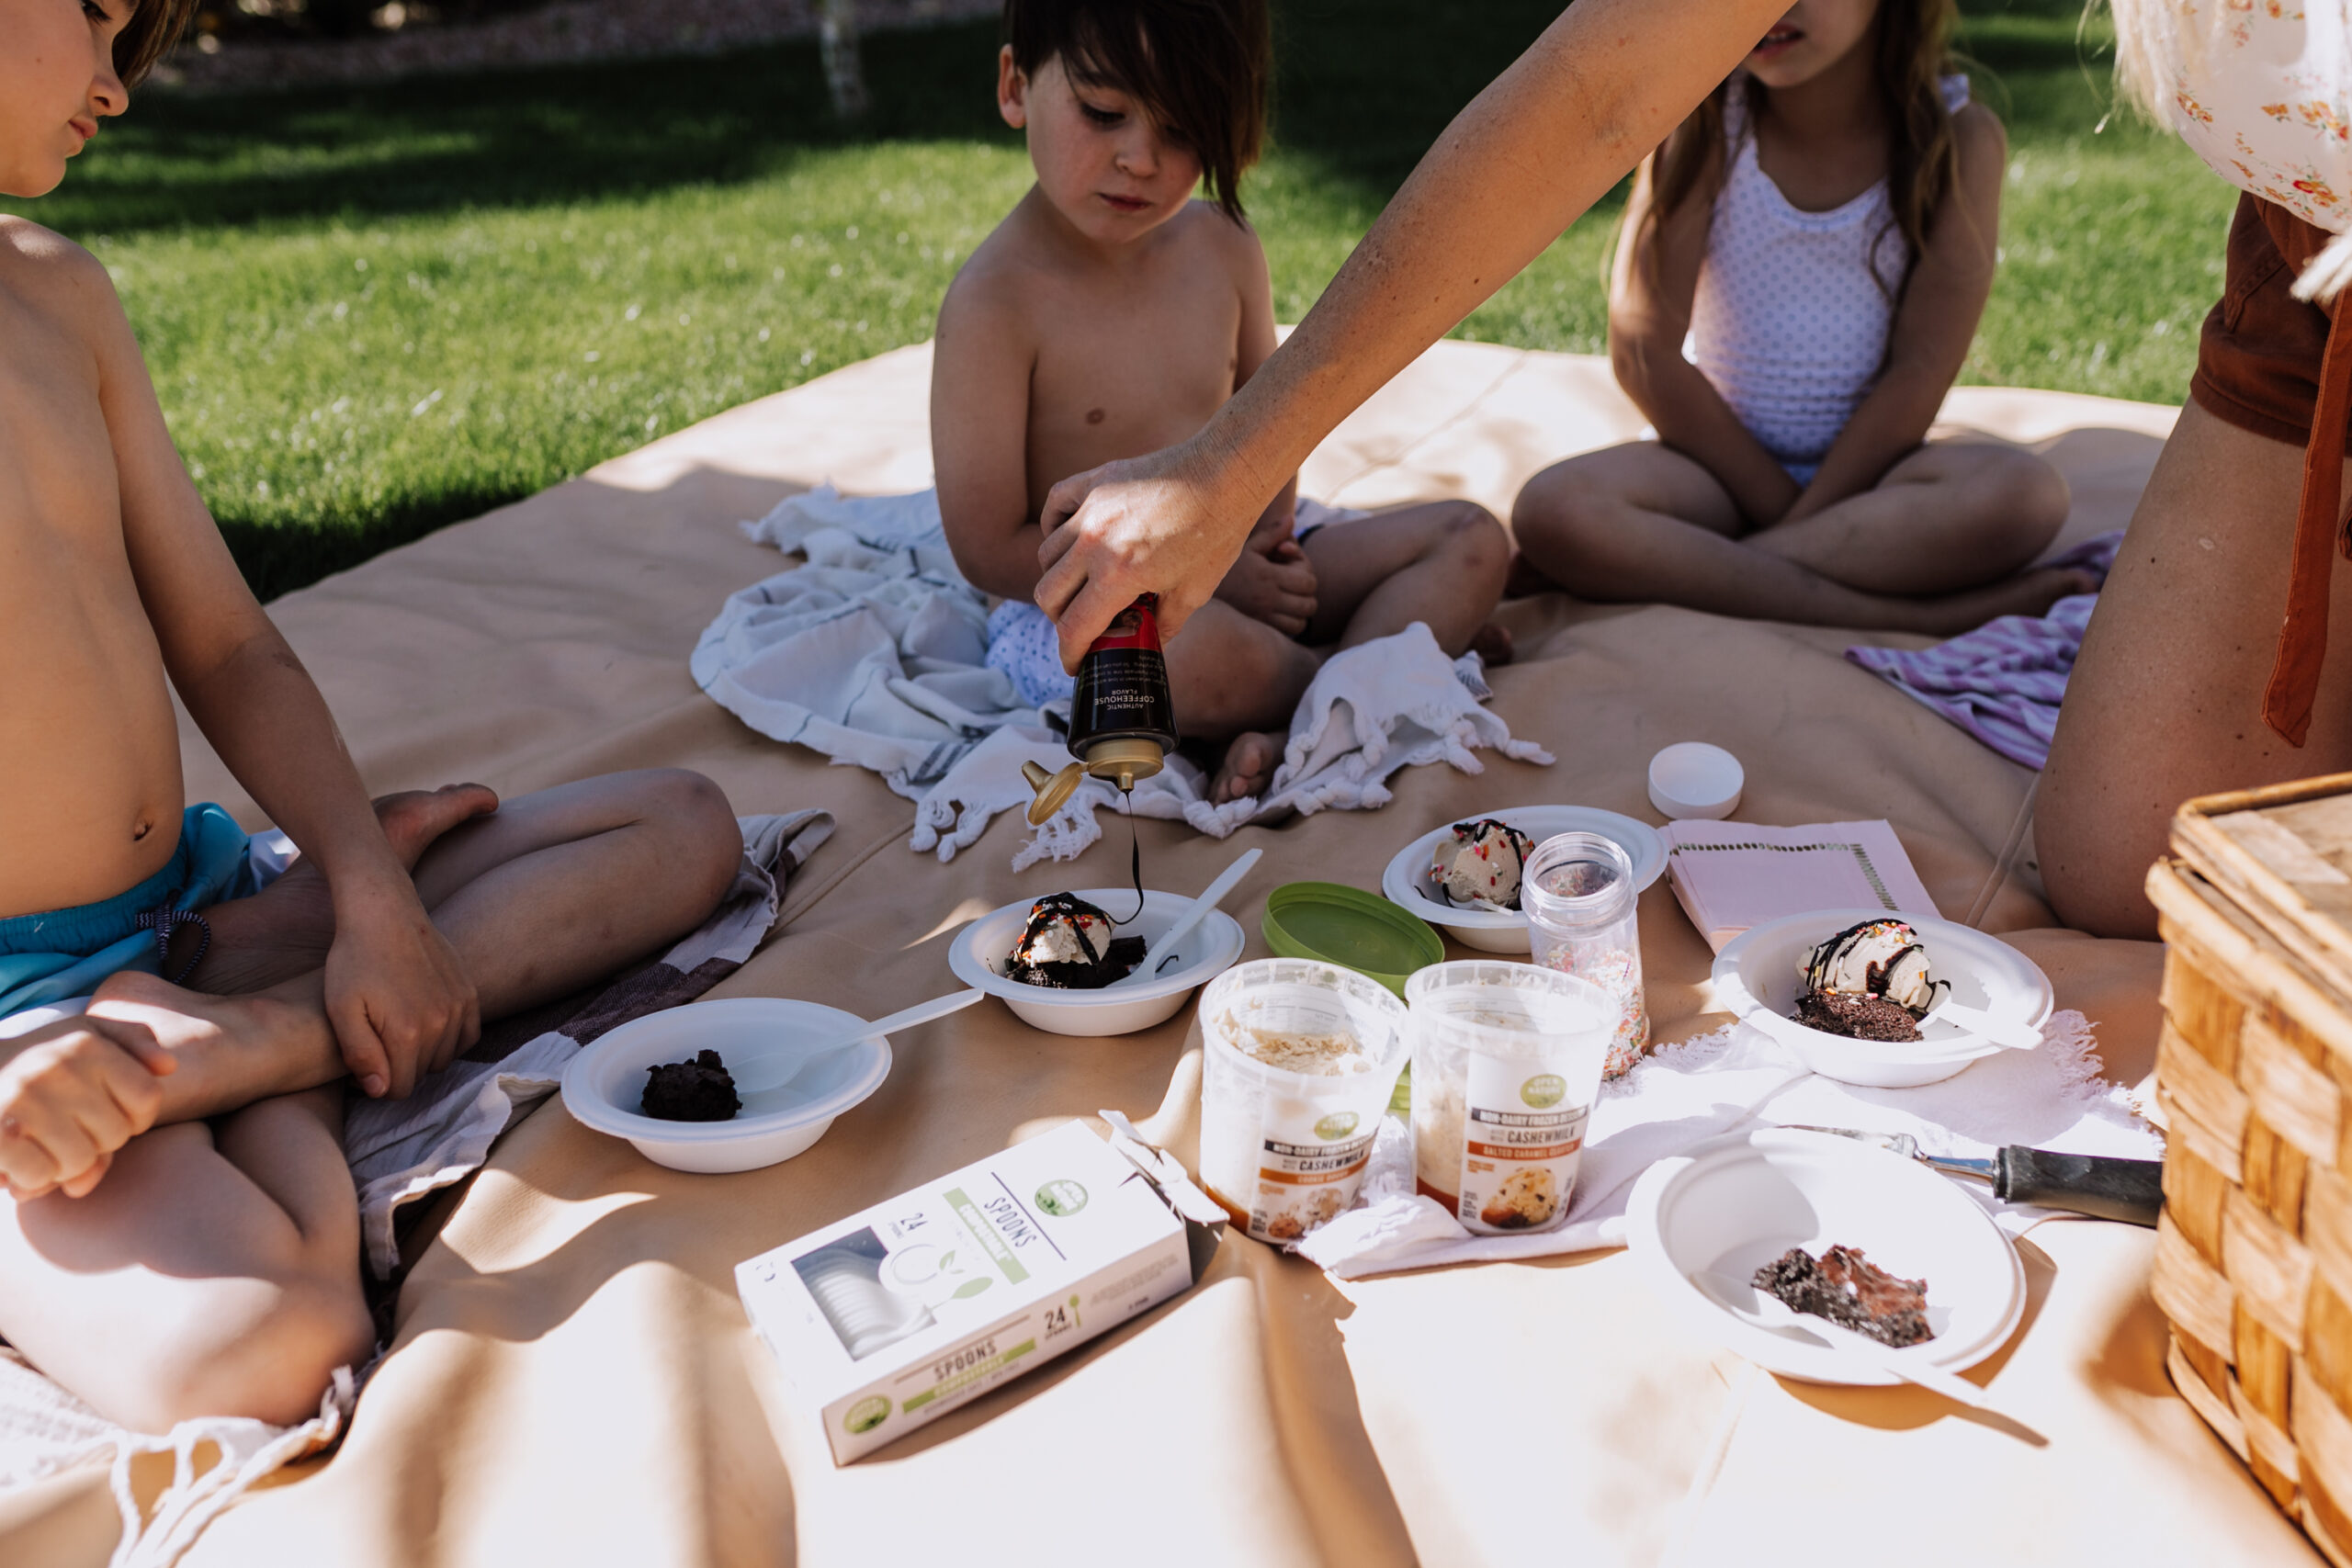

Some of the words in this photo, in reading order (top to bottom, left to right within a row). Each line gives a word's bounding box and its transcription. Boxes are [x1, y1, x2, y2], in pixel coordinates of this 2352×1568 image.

[1094, 695, 1155, 705] COFFEEHOUSE
[900, 1213, 928, 1231] 24
[984, 1197, 1037, 1247] SPOONS
[1045, 1305, 1066, 1329] 24
[933, 1338, 997, 1381] SPOONS
